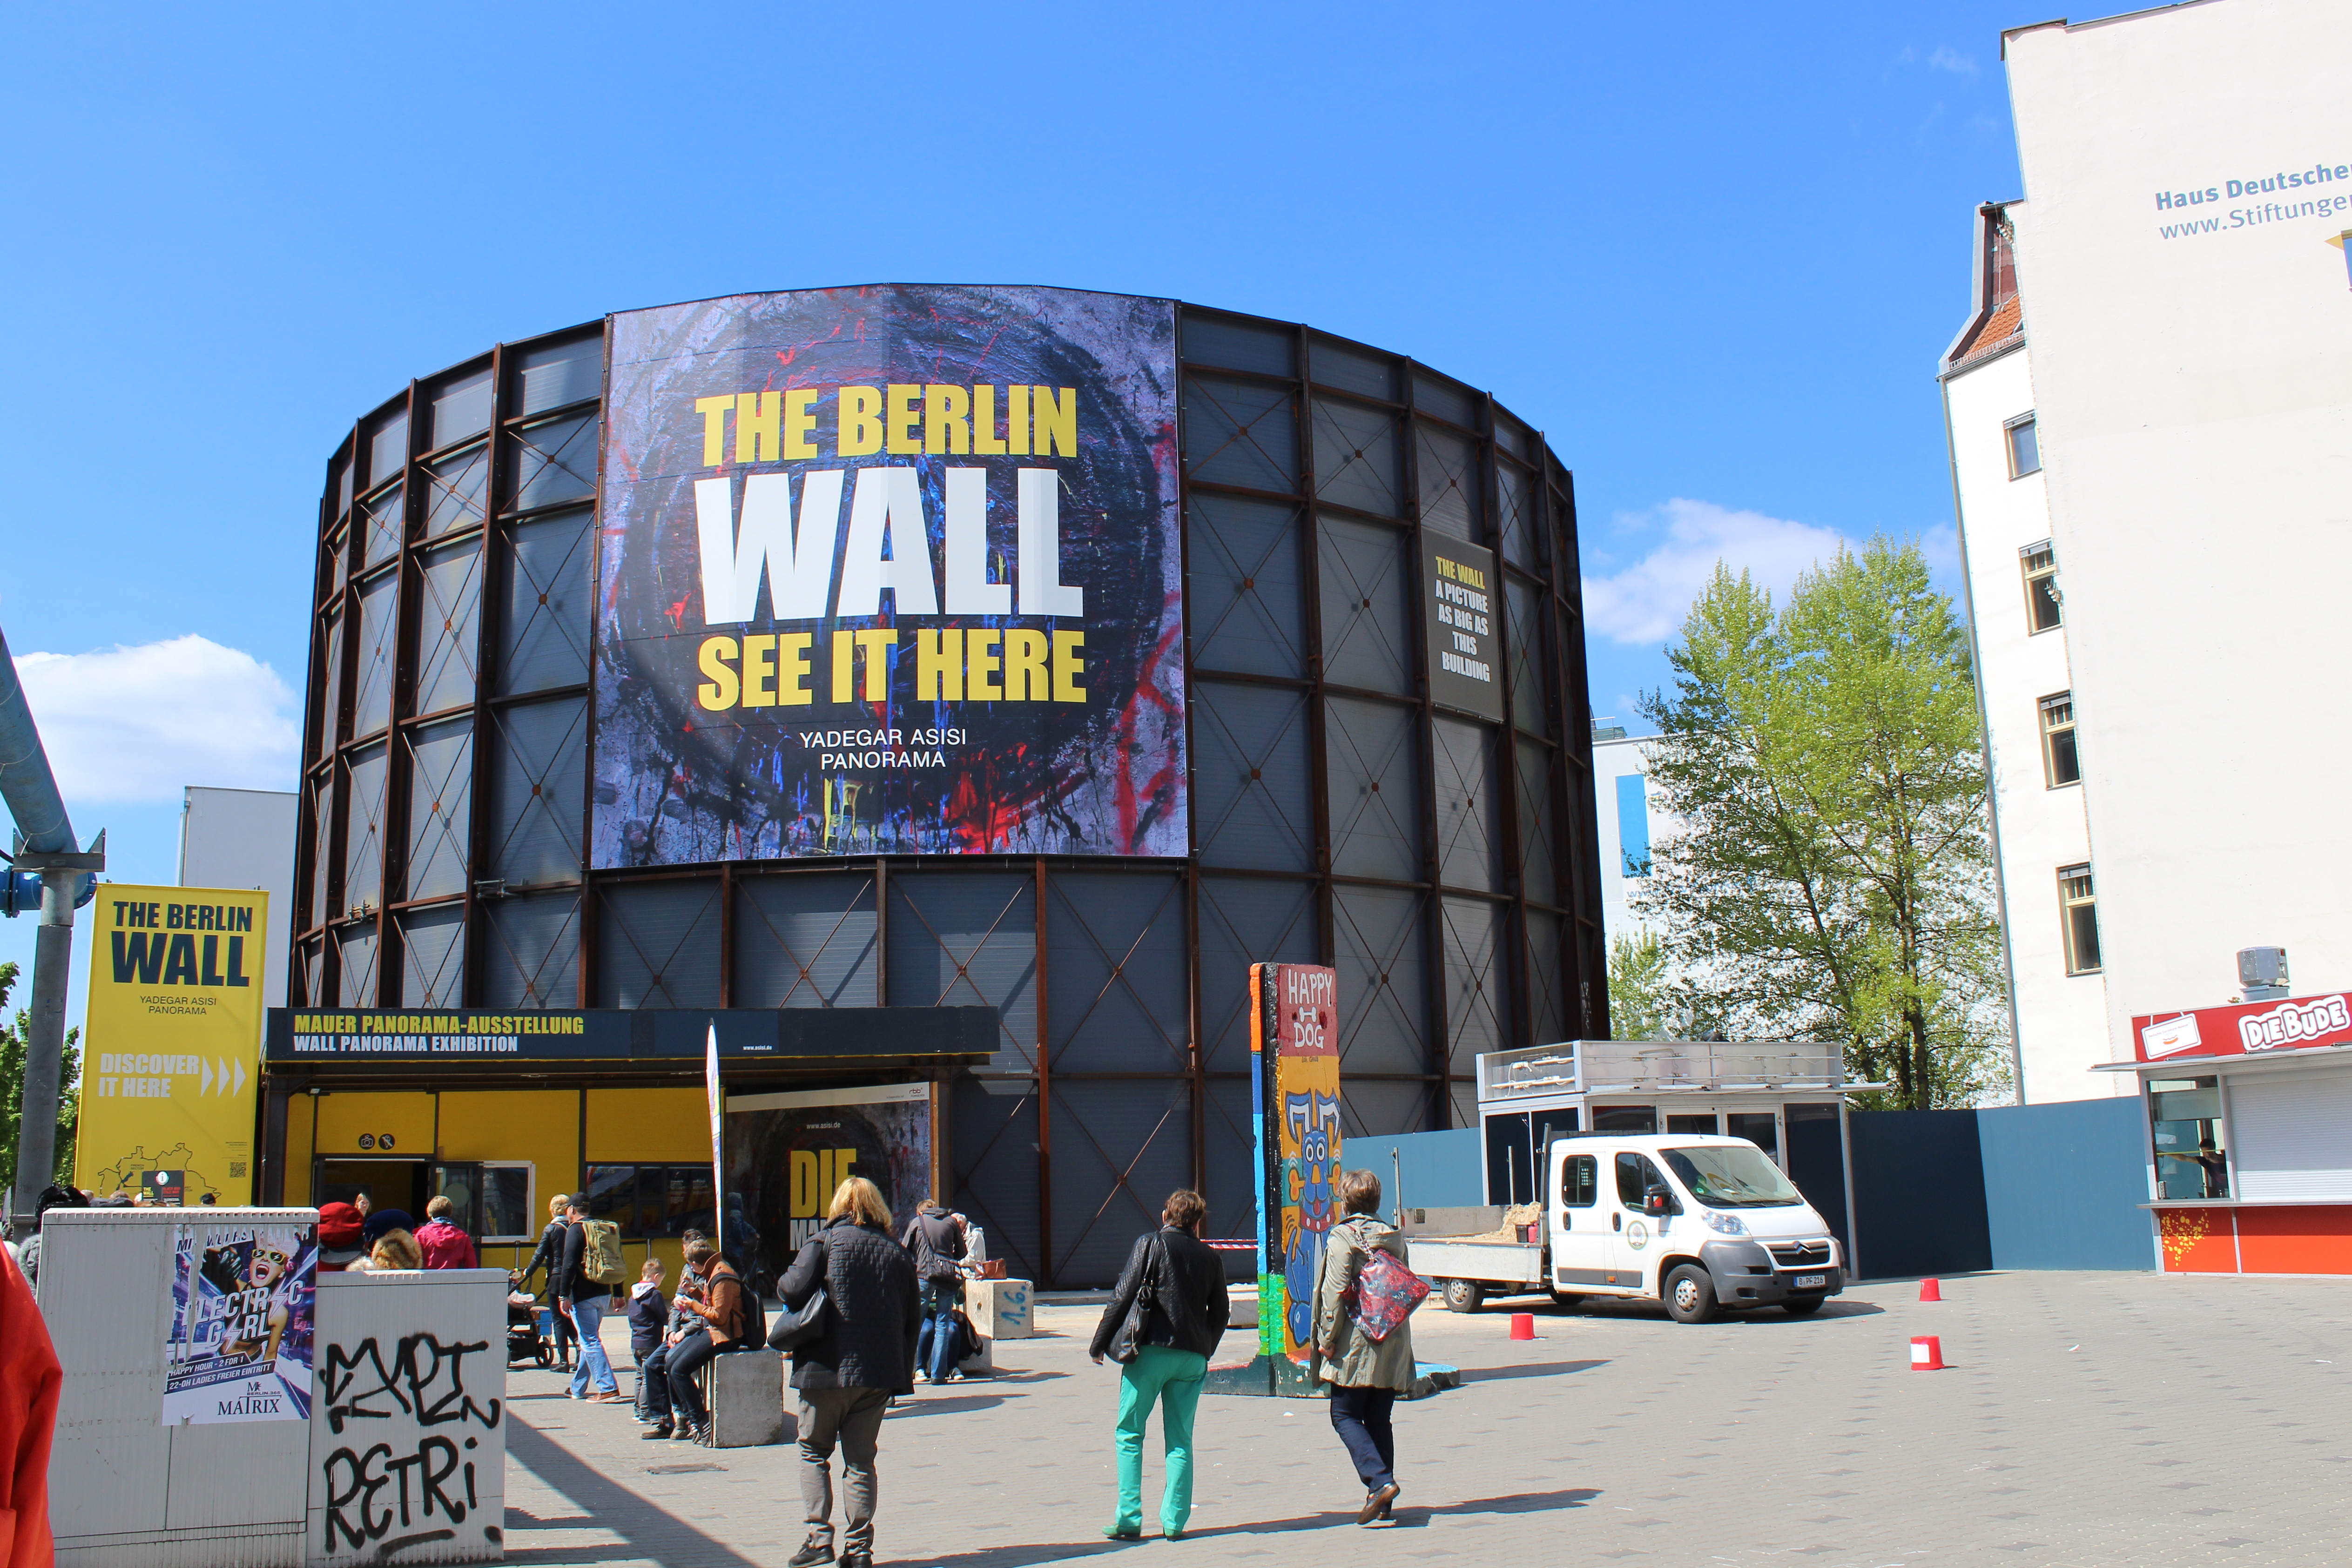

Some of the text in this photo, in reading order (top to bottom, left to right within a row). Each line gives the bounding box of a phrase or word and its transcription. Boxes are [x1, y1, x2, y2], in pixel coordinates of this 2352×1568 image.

[2155, 187, 2219, 211] Haus
[695, 384, 1077, 466] THE BERLIN
[694, 466, 1084, 626] WALL
[1435, 555, 1485, 589] THE WALL
[1435, 579, 1489, 613] A PICTURE
[1438, 603, 1489, 636] AS BIG AS
[1452, 631, 1477, 655] THIS
[698, 629, 1087, 712] SEE IT HERE
[1442, 651, 1490, 682] BUILDING
[800, 728, 966, 749] YADEGAR ASISI
[821, 750, 946, 771] PANORAMA
[113, 901, 253, 933] THE BERLIN
[111, 931, 250, 987] WALL
[1288, 969, 1333, 1007] HAPPY
[140, 996, 217, 1006] YADEGAR ASISI
[148, 1006, 207, 1015] PANORAMA
[294, 1015, 584, 1035] MAUER PANORAMA-AUSSTELLUNG
[1294, 1022, 1324, 1049] DOG
[2245, 1000, 2347, 1048] DIE BUDE
[294, 1035, 518, 1052] WALL PANORAMA EXHIBITION
[101, 1053, 199, 1075] DISCOVER
[99, 1077, 171, 1098] IT HERE
[192, 1374, 216, 1386] LADIES
[217, 1369, 240, 1380] FREIER
[241, 1363, 272, 1376] EINTRITT
[194, 1361, 213, 1372] HOUR
[225, 1357, 238, 1366] FOR
[218, 1395, 282, 1415] MATRIX
